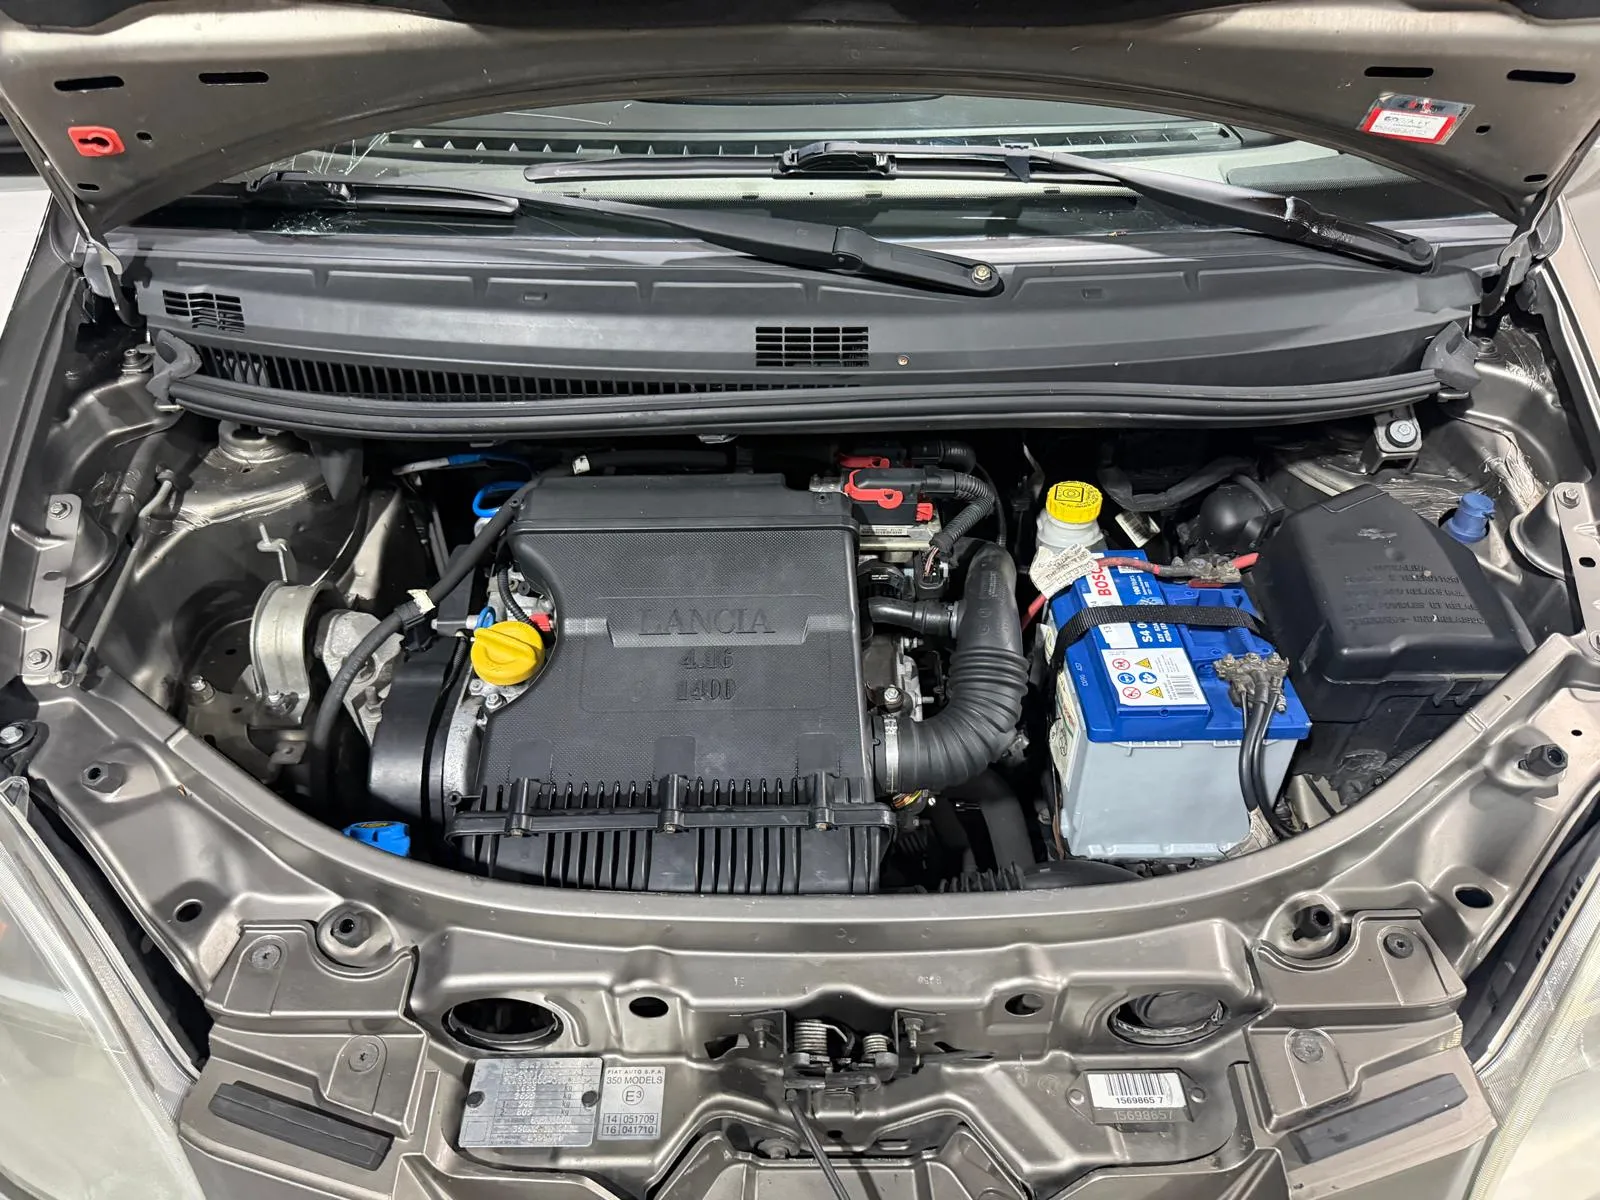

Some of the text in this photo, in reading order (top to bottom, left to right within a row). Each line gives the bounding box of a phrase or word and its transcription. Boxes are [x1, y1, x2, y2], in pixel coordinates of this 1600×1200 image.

[1092, 566, 1112, 597] BOSC
[638, 607, 776, 636] LANCIA
[1139, 630, 1153, 643] S4
[606, 1076, 663, 1084] 350 MODELS
[606, 1115, 655, 1123] 14 051709
[1114, 1110, 1174, 1121] 15698657
[605, 1125, 654, 1134] 16 041710
